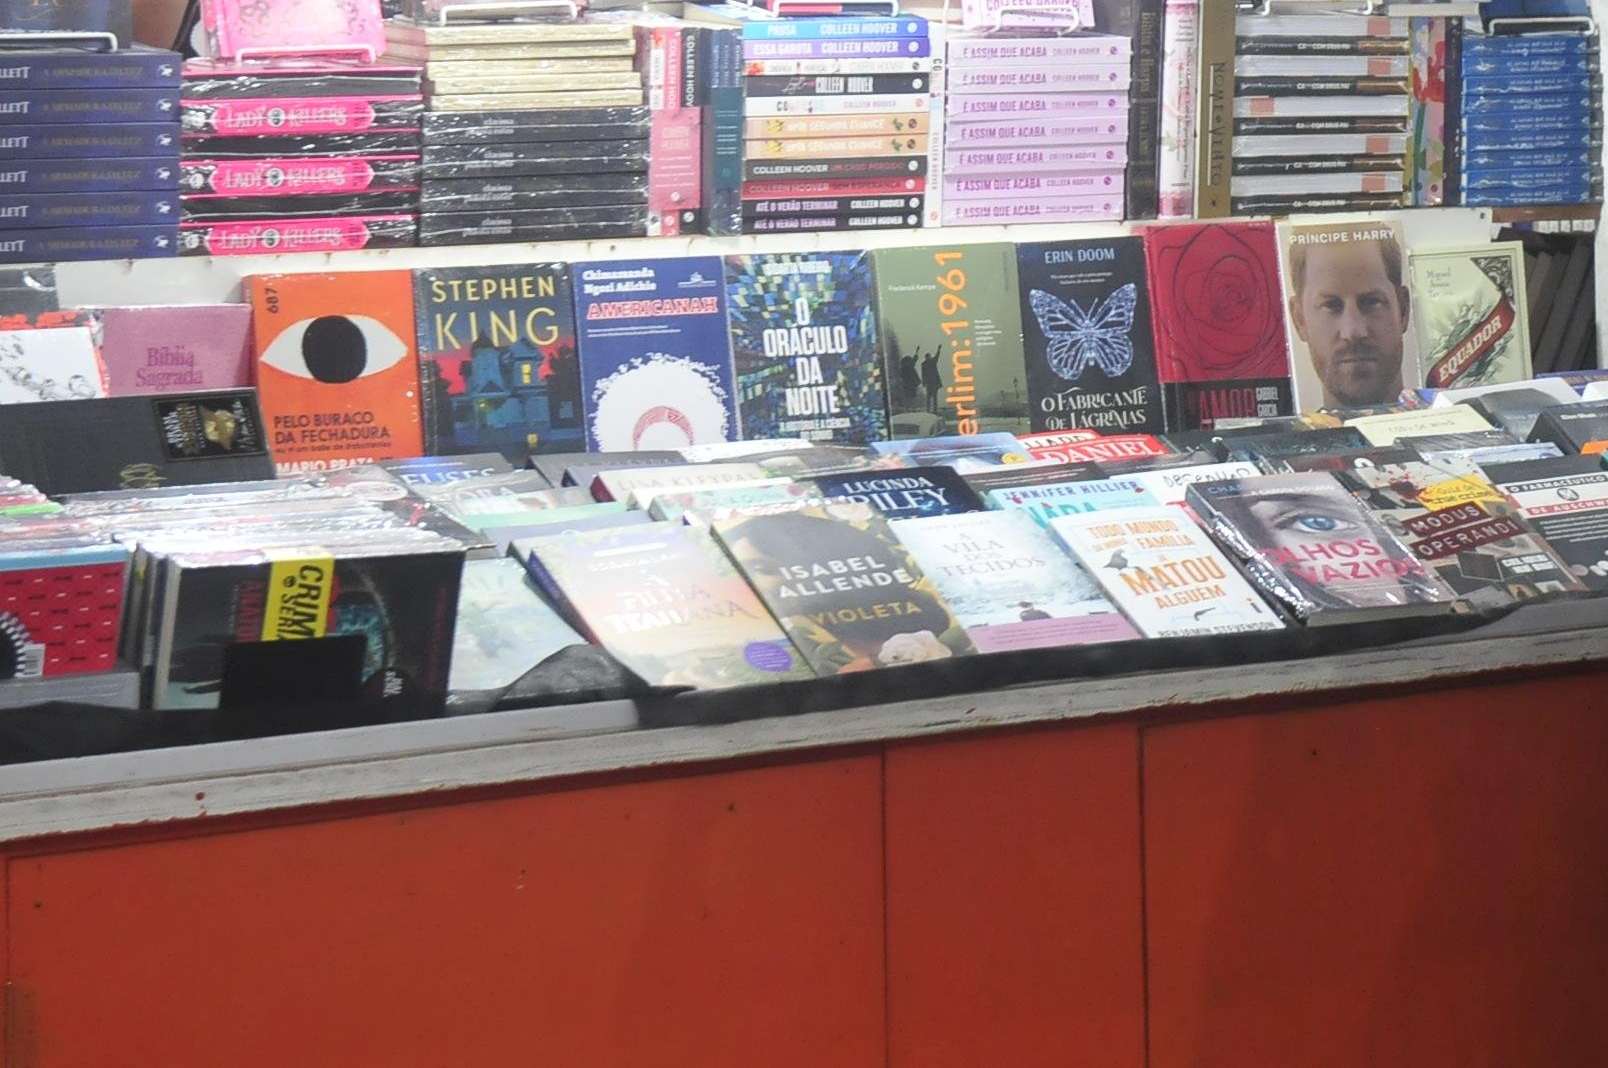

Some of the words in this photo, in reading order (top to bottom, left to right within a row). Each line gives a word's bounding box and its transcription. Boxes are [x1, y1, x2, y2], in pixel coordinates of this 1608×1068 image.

[821, 43, 861, 54] COLLEEN
[752, 165, 792, 175] COLLEEN
[793, 164, 829, 174] HOOVER
[964, 180, 992, 192] ASSIM
[994, 179, 1011, 190] QUE
[1013, 178, 1042, 189] ACABA
[1289, 231, 1350, 246] PRÍNCIPE
[1353, 230, 1395, 242] HARRY
[1045, 250, 1074, 264] ERIN
[1078, 248, 1115, 262] DOOM
[266, 288, 278, 314] 687
[431, 276, 555, 303] STEPHEN
[586, 296, 719, 320] AMERICANAH
[795, 298, 810, 326] O
[435, 307, 559, 351] KING
[763, 322, 848, 358] ORÁCULO
[1438, 314, 1503, 383] EQUADOR
[136, 368, 203, 388] Sagrada
[795, 357, 824, 383] DA
[785, 384, 840, 416] NOITE
[1041, 397, 1056, 413] O
[1056, 386, 1148, 412] FABRICANTE
[274, 414, 312, 430] PELO
[313, 410, 374, 427] BURACO
[1070, 408, 1147, 431] LÁGRIMAS
[275, 430, 297, 445] DA
[300, 425, 390, 443] FECHADURA
[1046, 439, 1165, 466] DANIEL
[843, 476, 934, 495] LUCINDA
[1522, 474, 1607, 492] FARMACÊUTICO
[1410, 505, 1483, 533] MODUS
[1529, 506, 1545, 516] DE
[944, 538, 1006, 555] VILA
[1417, 519, 1521, 558] OPERANDI
[1256, 539, 1380, 566] OLHOS
[781, 555, 886, 581] ISABEL
[937, 557, 1047, 578] TECIDOS
[1119, 555, 1227, 597] MATOU
[1292, 557, 1427, 583] VAZIOS
[780, 569, 913, 599] ALLENDE
[809, 601, 923, 626] VIOLETA
